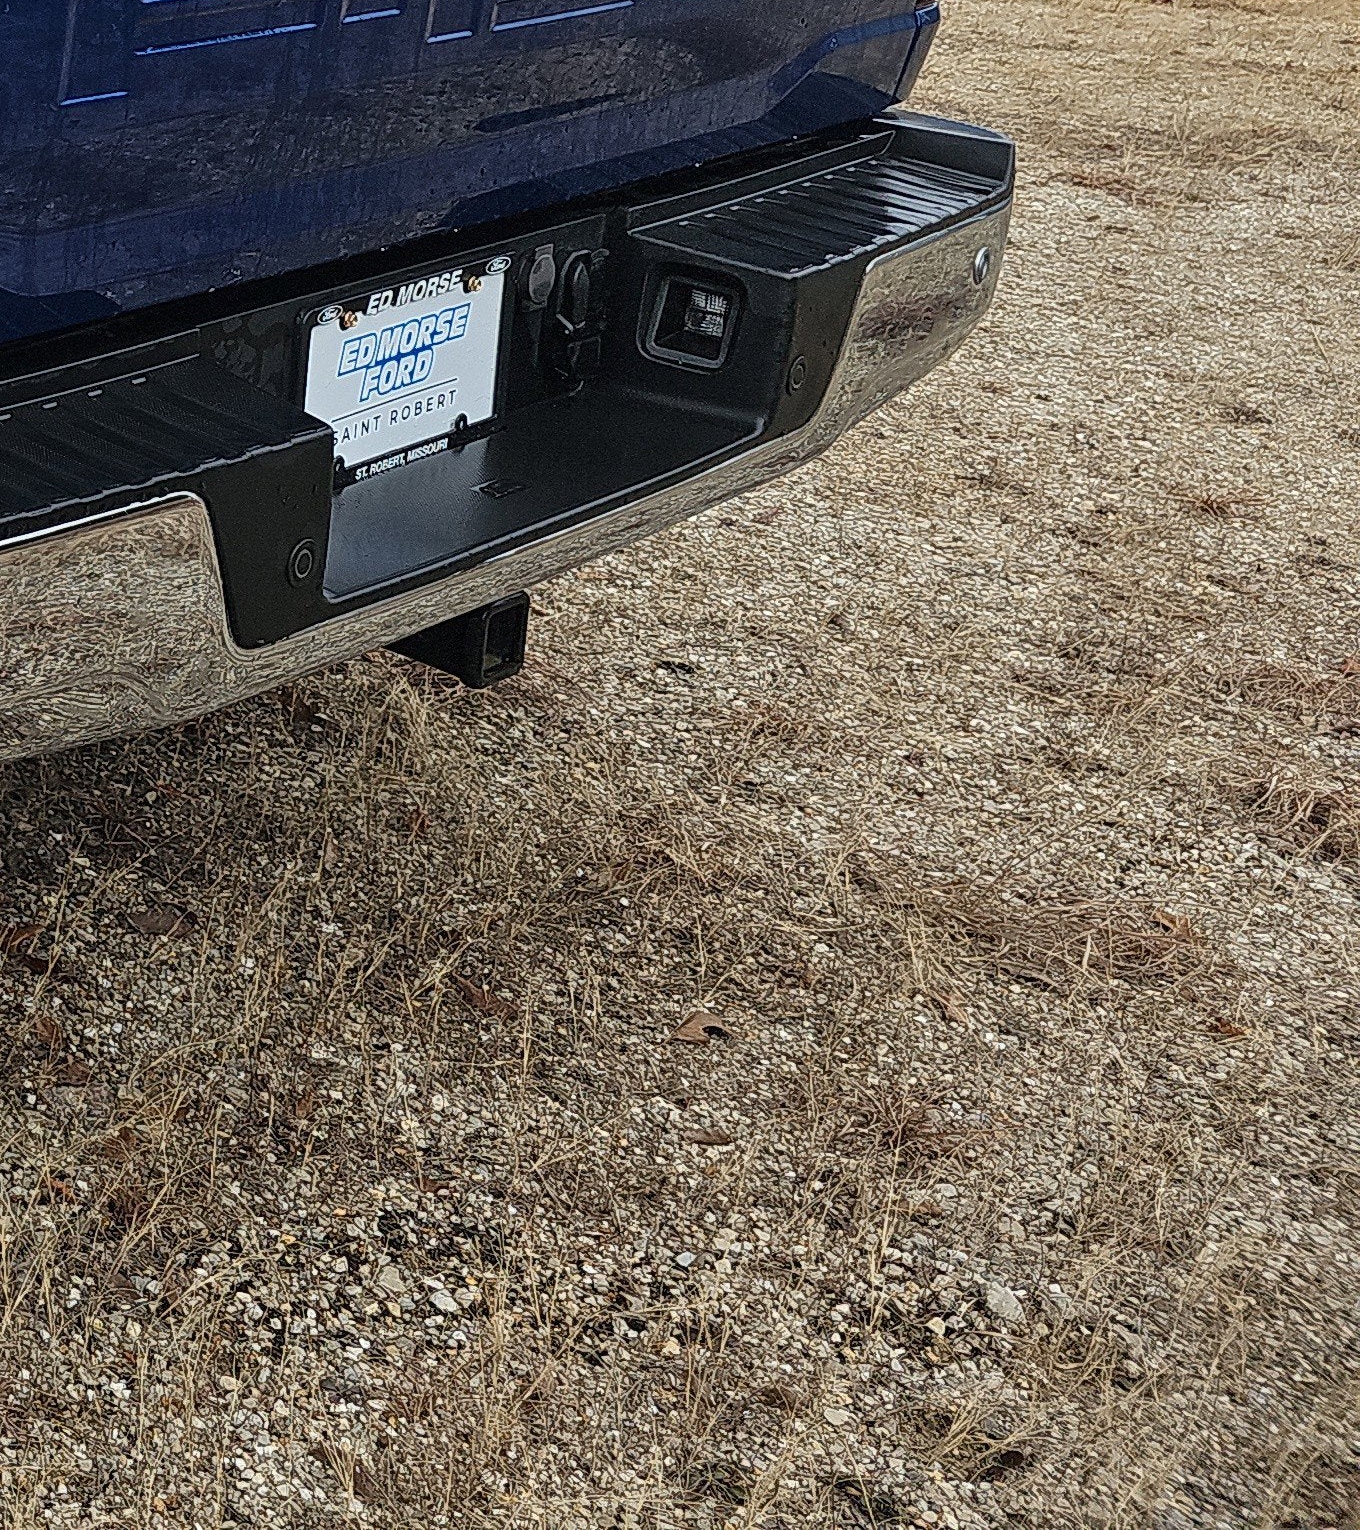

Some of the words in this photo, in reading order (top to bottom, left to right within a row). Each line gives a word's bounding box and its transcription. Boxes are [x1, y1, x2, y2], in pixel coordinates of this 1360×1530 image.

[366, 292, 393, 316] ED
[396, 270, 463, 307] MORSE
[337, 334, 378, 377] ED
[376, 302, 471, 363] MORSE
[359, 349, 435, 402] FORD
[333, 415, 381, 446] SAINT
[390, 390, 457, 425] ROBERT
[407, 438, 449, 461] MISSOURI
